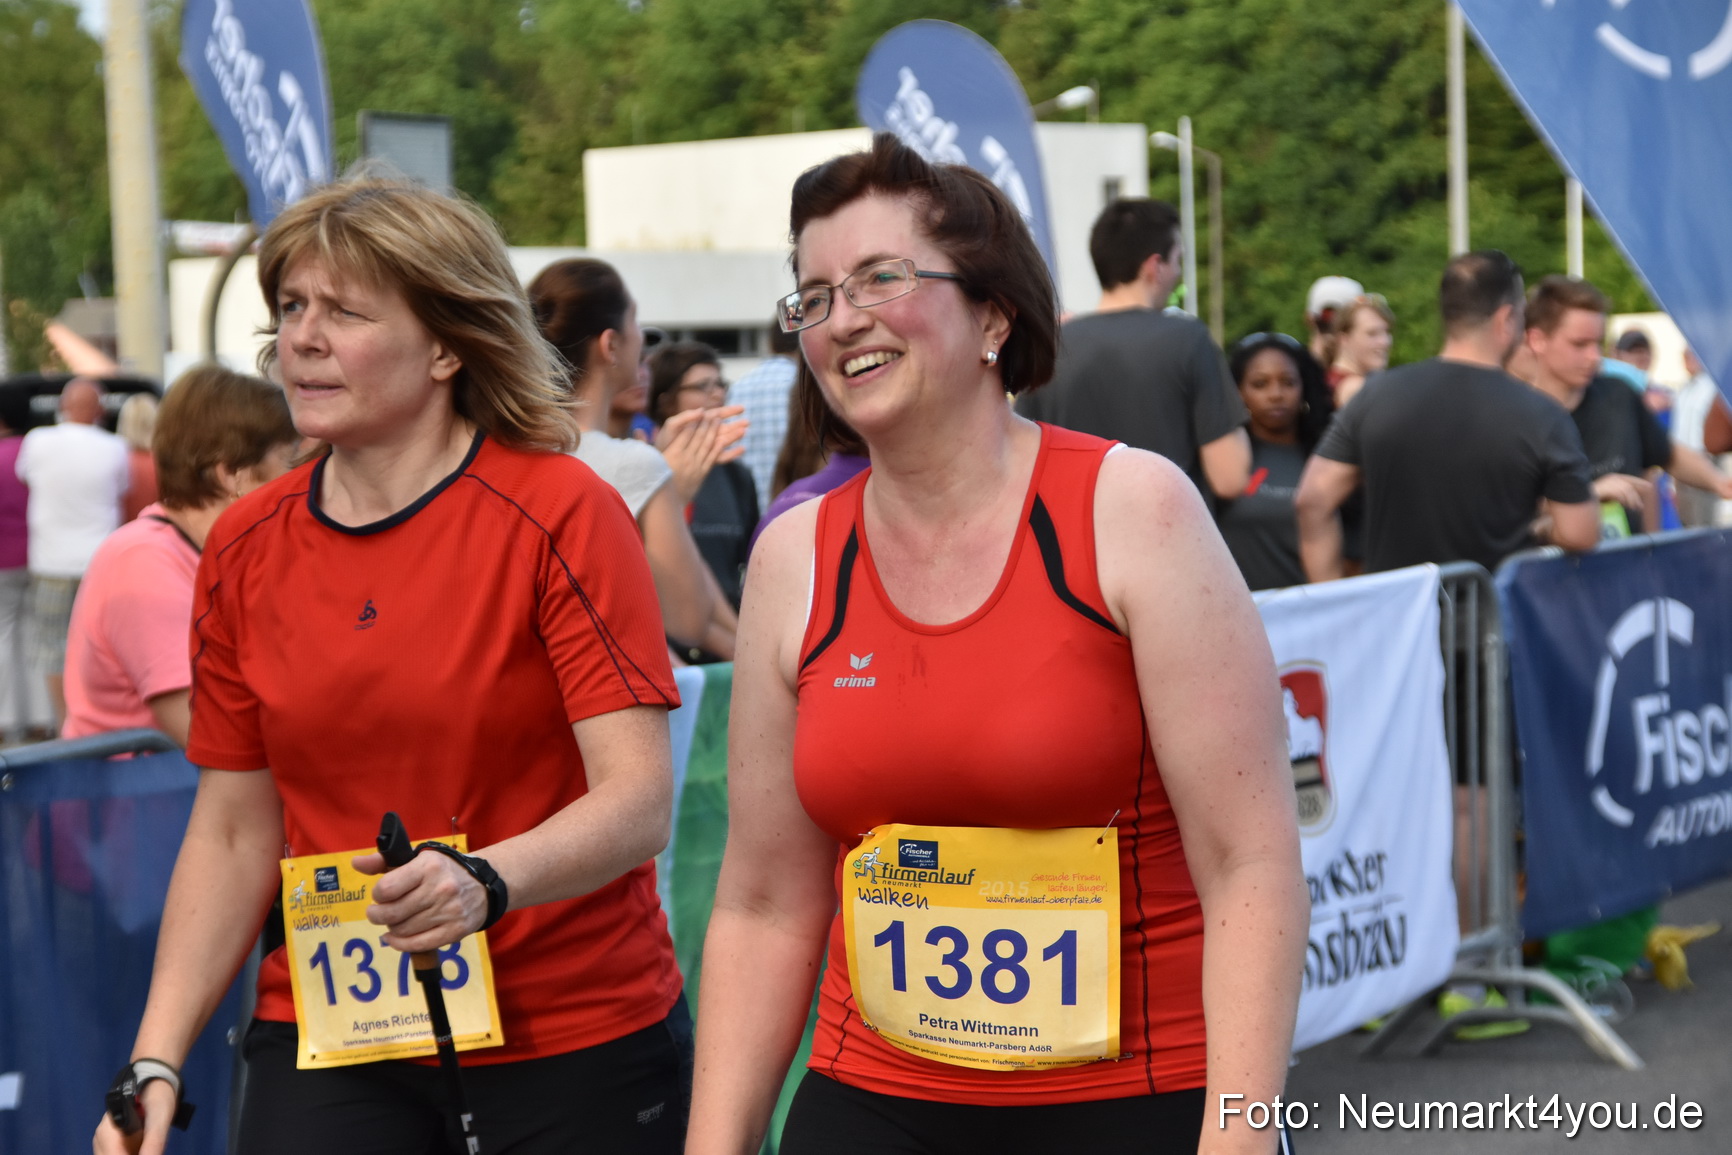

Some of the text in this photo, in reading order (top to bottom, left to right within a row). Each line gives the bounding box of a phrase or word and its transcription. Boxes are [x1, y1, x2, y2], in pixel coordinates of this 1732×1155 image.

[833, 674, 876, 688] erima
[905, 847, 933, 855] Fischer
[881, 863, 976, 885] firmenlauf
[882, 879, 922, 888] neumarkt
[1072, 873, 1101, 882] Firmen
[305, 884, 366, 906] firmenlauf
[858, 887, 929, 910] walken
[978, 881, 1029, 897] 2015
[985, 894, 1103, 906] www.firmenlauf-oberpfalz.de
[293, 914, 340, 931] walken
[874, 920, 1077, 1006] 1381
[352, 1012, 432, 1034] Agnes Richte
[919, 1013, 1039, 1037] Petra Wittmann
[908, 1029, 947, 1043] Sparkasse
[948, 1037, 1026, 1052] Neumarkt-Parsberg
[1029, 1044, 1052, 1053] AdöR
